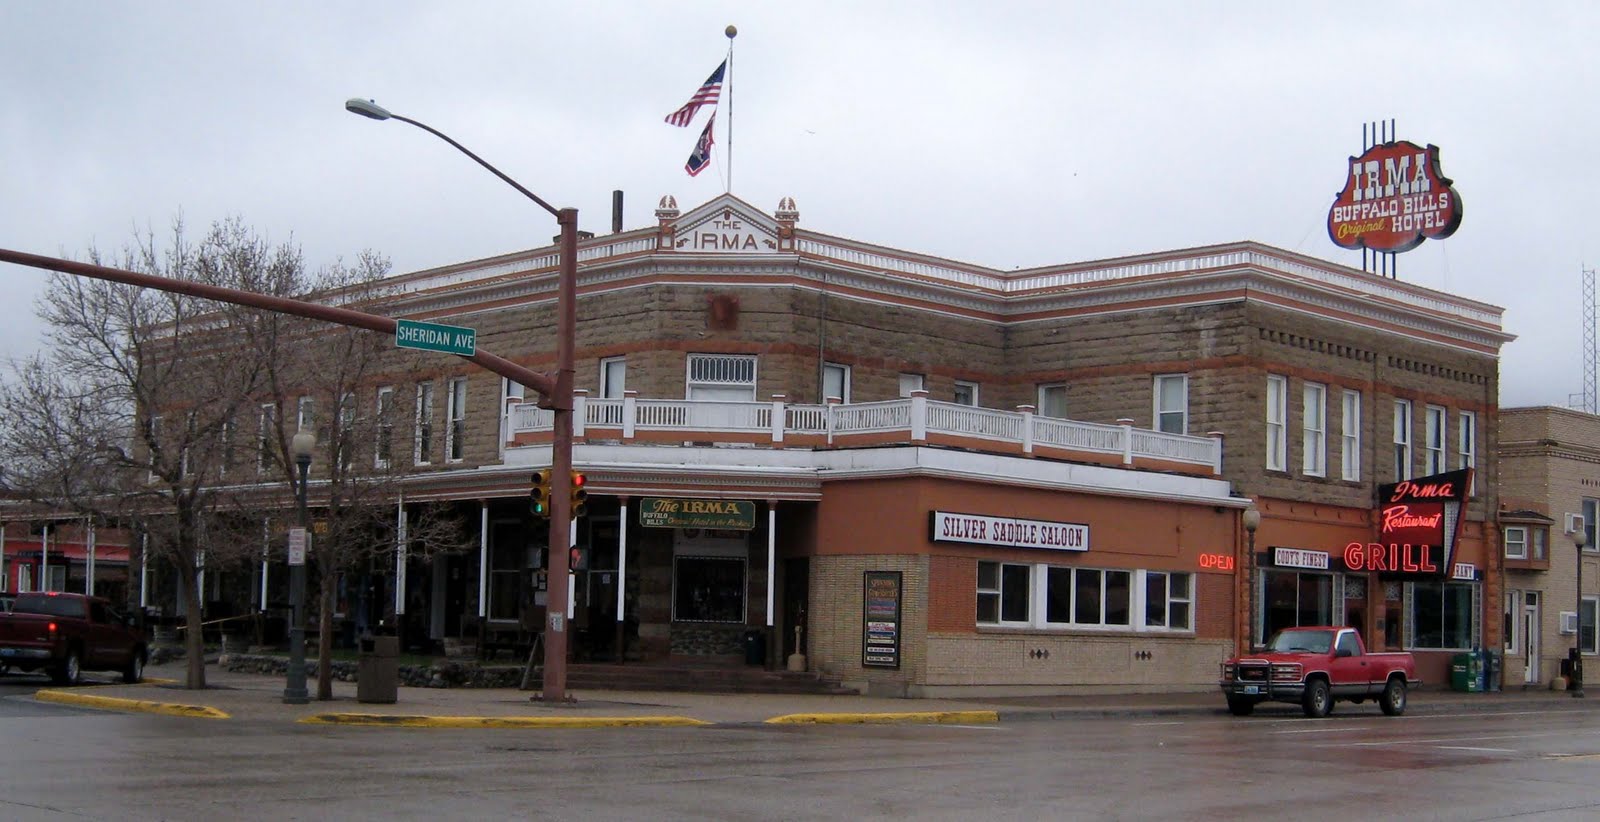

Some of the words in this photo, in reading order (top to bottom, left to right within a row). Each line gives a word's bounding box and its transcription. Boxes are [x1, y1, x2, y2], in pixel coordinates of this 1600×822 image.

[1353, 153, 1430, 201] IRMA
[1333, 199, 1398, 223] BUFFALO
[1403, 192, 1448, 214] BILLS
[713, 221, 741, 230] THE
[1337, 218, 1385, 238] Original
[1392, 211, 1445, 233] HOTEL
[694, 231, 758, 250] IRMA
[398, 326, 450, 346] SHERIDAN
[454, 334, 474, 349] AVE
[1391, 481, 1455, 502] Irma
[652, 499, 679, 513] The
[682, 501, 741, 514] IRMA
[1382, 505, 1442, 533] Restaurant
[943, 516, 987, 540] SILVER
[993, 521, 1036, 544] SADDLE
[1041, 525, 1083, 547] SALOON
[1199, 553, 1234, 570] OPEN
[1302, 552, 1327, 568] FINEST
[1344, 542, 1436, 572] GRILL
